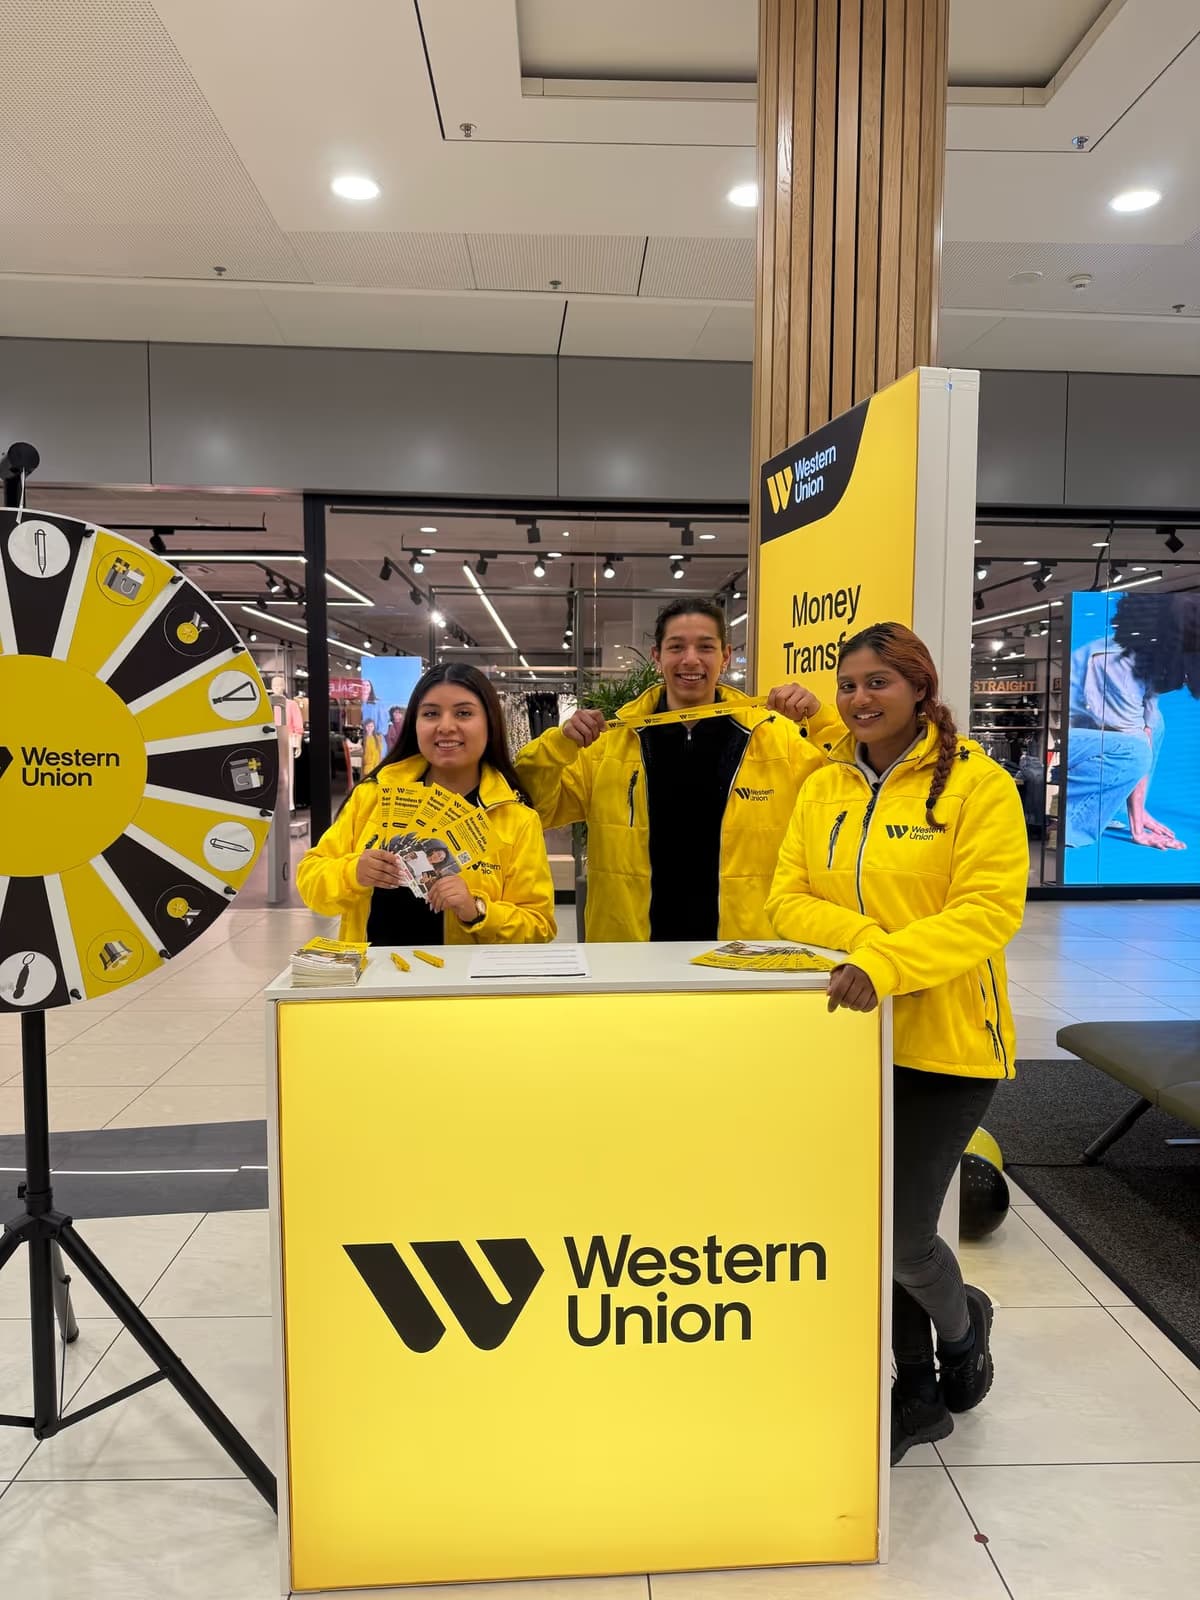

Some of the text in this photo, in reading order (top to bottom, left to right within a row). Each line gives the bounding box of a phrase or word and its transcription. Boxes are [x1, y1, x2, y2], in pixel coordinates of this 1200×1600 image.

[794, 445, 837, 481] Western
[795, 475, 824, 503] Union
[792, 585, 861, 629] Money
[974, 680, 1036, 691] STRAIGHT
[21, 746, 120, 767] Western
[22, 768, 93, 787] Union
[909, 833, 934, 841] Union
[564, 1235, 827, 1288] Western
[567, 1292, 752, 1347] Union
